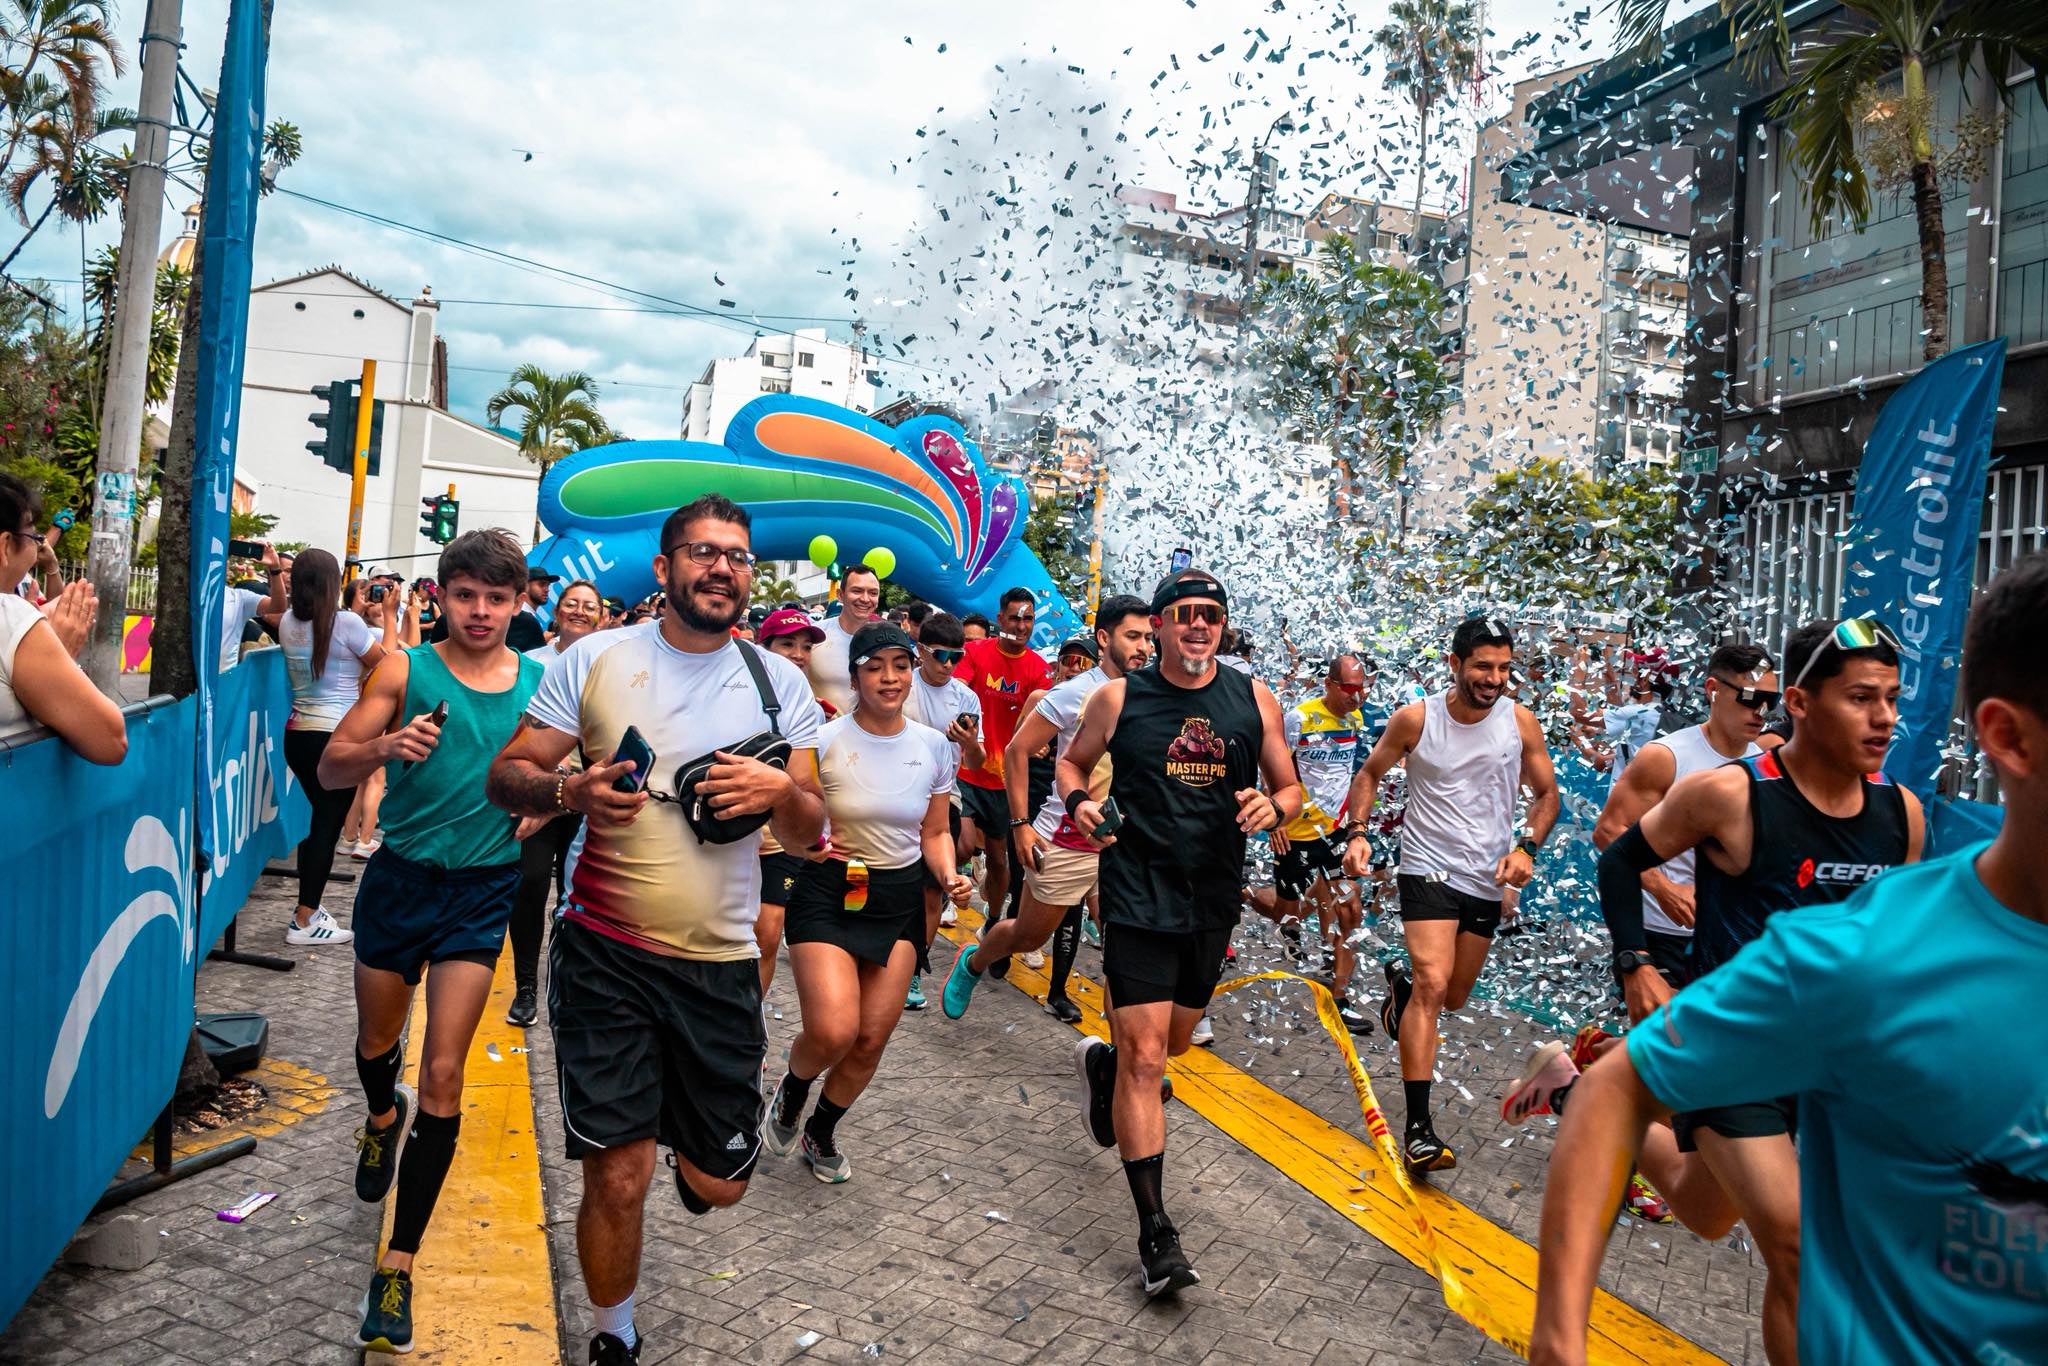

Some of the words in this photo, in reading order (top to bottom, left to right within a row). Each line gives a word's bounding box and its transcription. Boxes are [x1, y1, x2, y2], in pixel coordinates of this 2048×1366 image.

[1166, 762, 1209, 776] MASTER
[1210, 764, 1226, 777] PIG
[1815, 862, 1890, 881] CEFA
